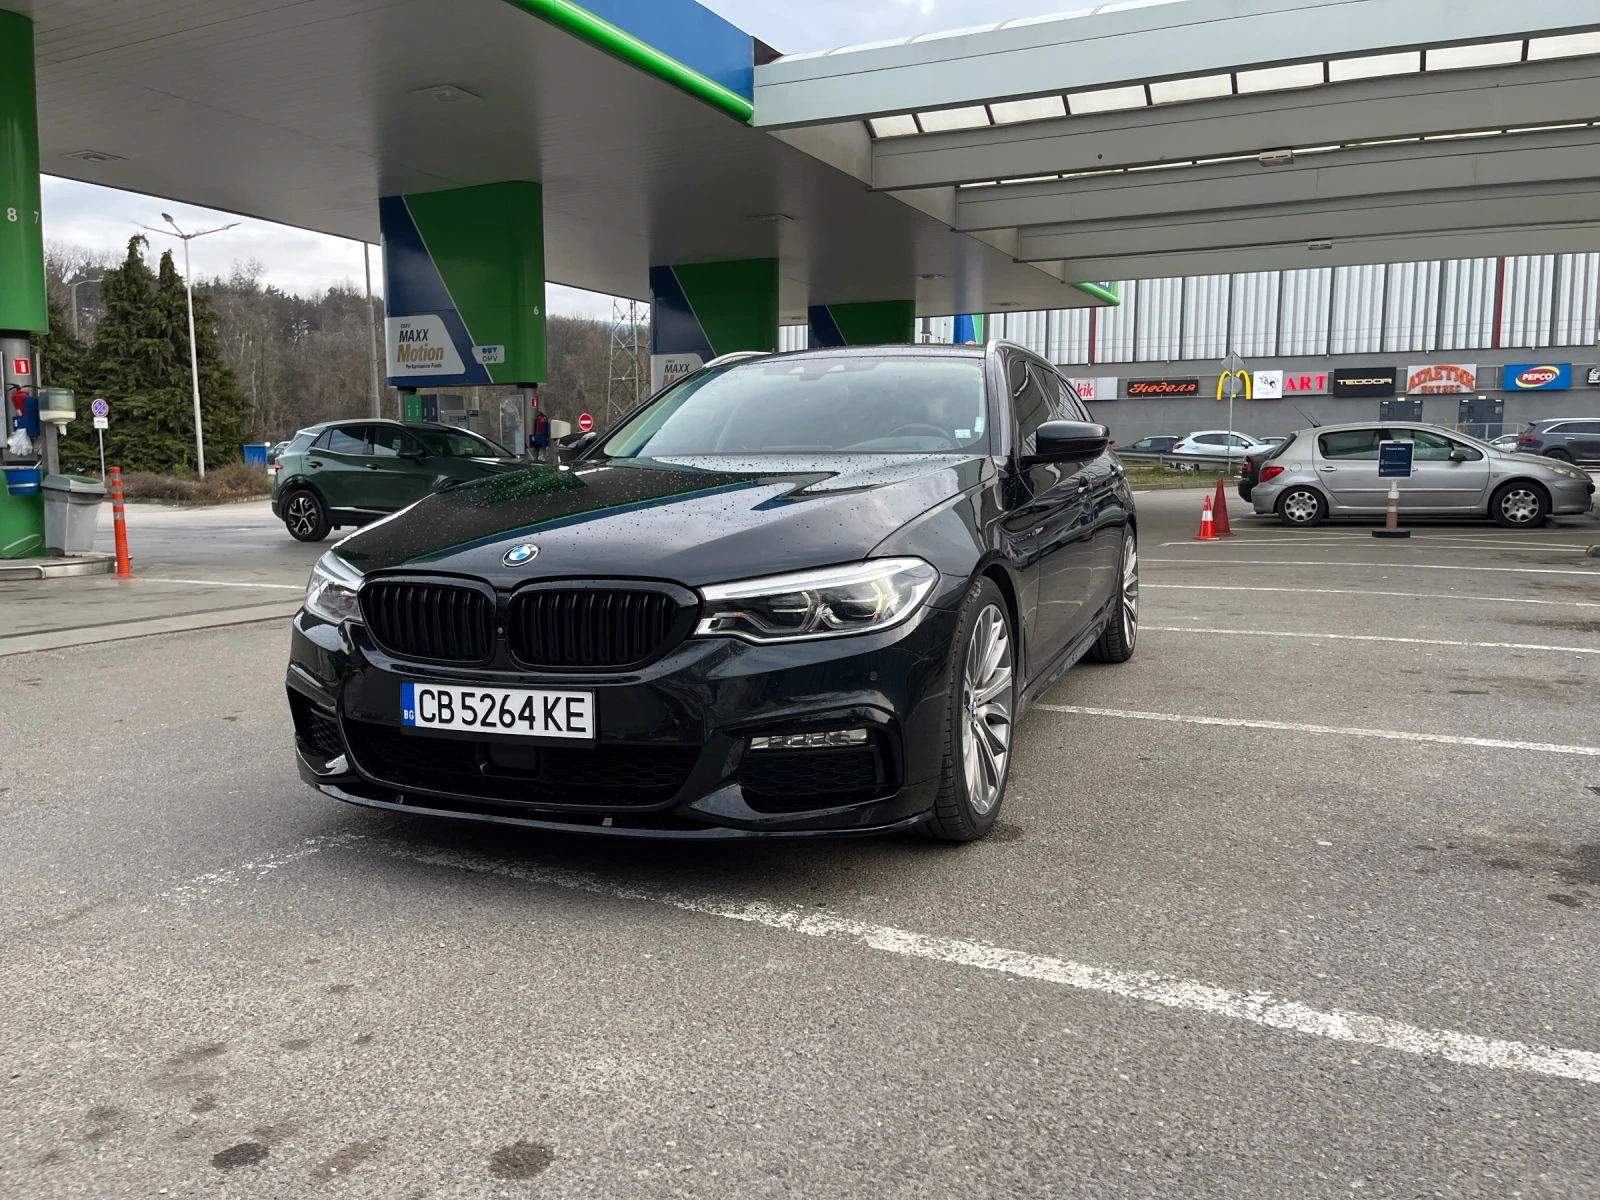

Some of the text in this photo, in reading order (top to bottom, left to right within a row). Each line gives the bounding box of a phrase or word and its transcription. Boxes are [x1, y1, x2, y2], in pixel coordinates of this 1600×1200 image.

[7, 207, 18, 222] 8
[33, 210, 40, 224] 7
[533, 306, 540, 315] 6
[399, 328, 429, 343] MAXX
[396, 343, 445, 363] Motion
[482, 355, 498, 363] OMV
[664, 363, 690, 374] MAXX
[1283, 375, 1328, 391] ART
[1336, 378, 1393, 386] TEODOR
[1406, 365, 1475, 393] АТЛЕТИК
[1522, 373, 1553, 381] PEPCO
[403, 709, 415, 720] BG
[461, 692, 535, 730] 5264
[543, 696, 587, 732] KE
